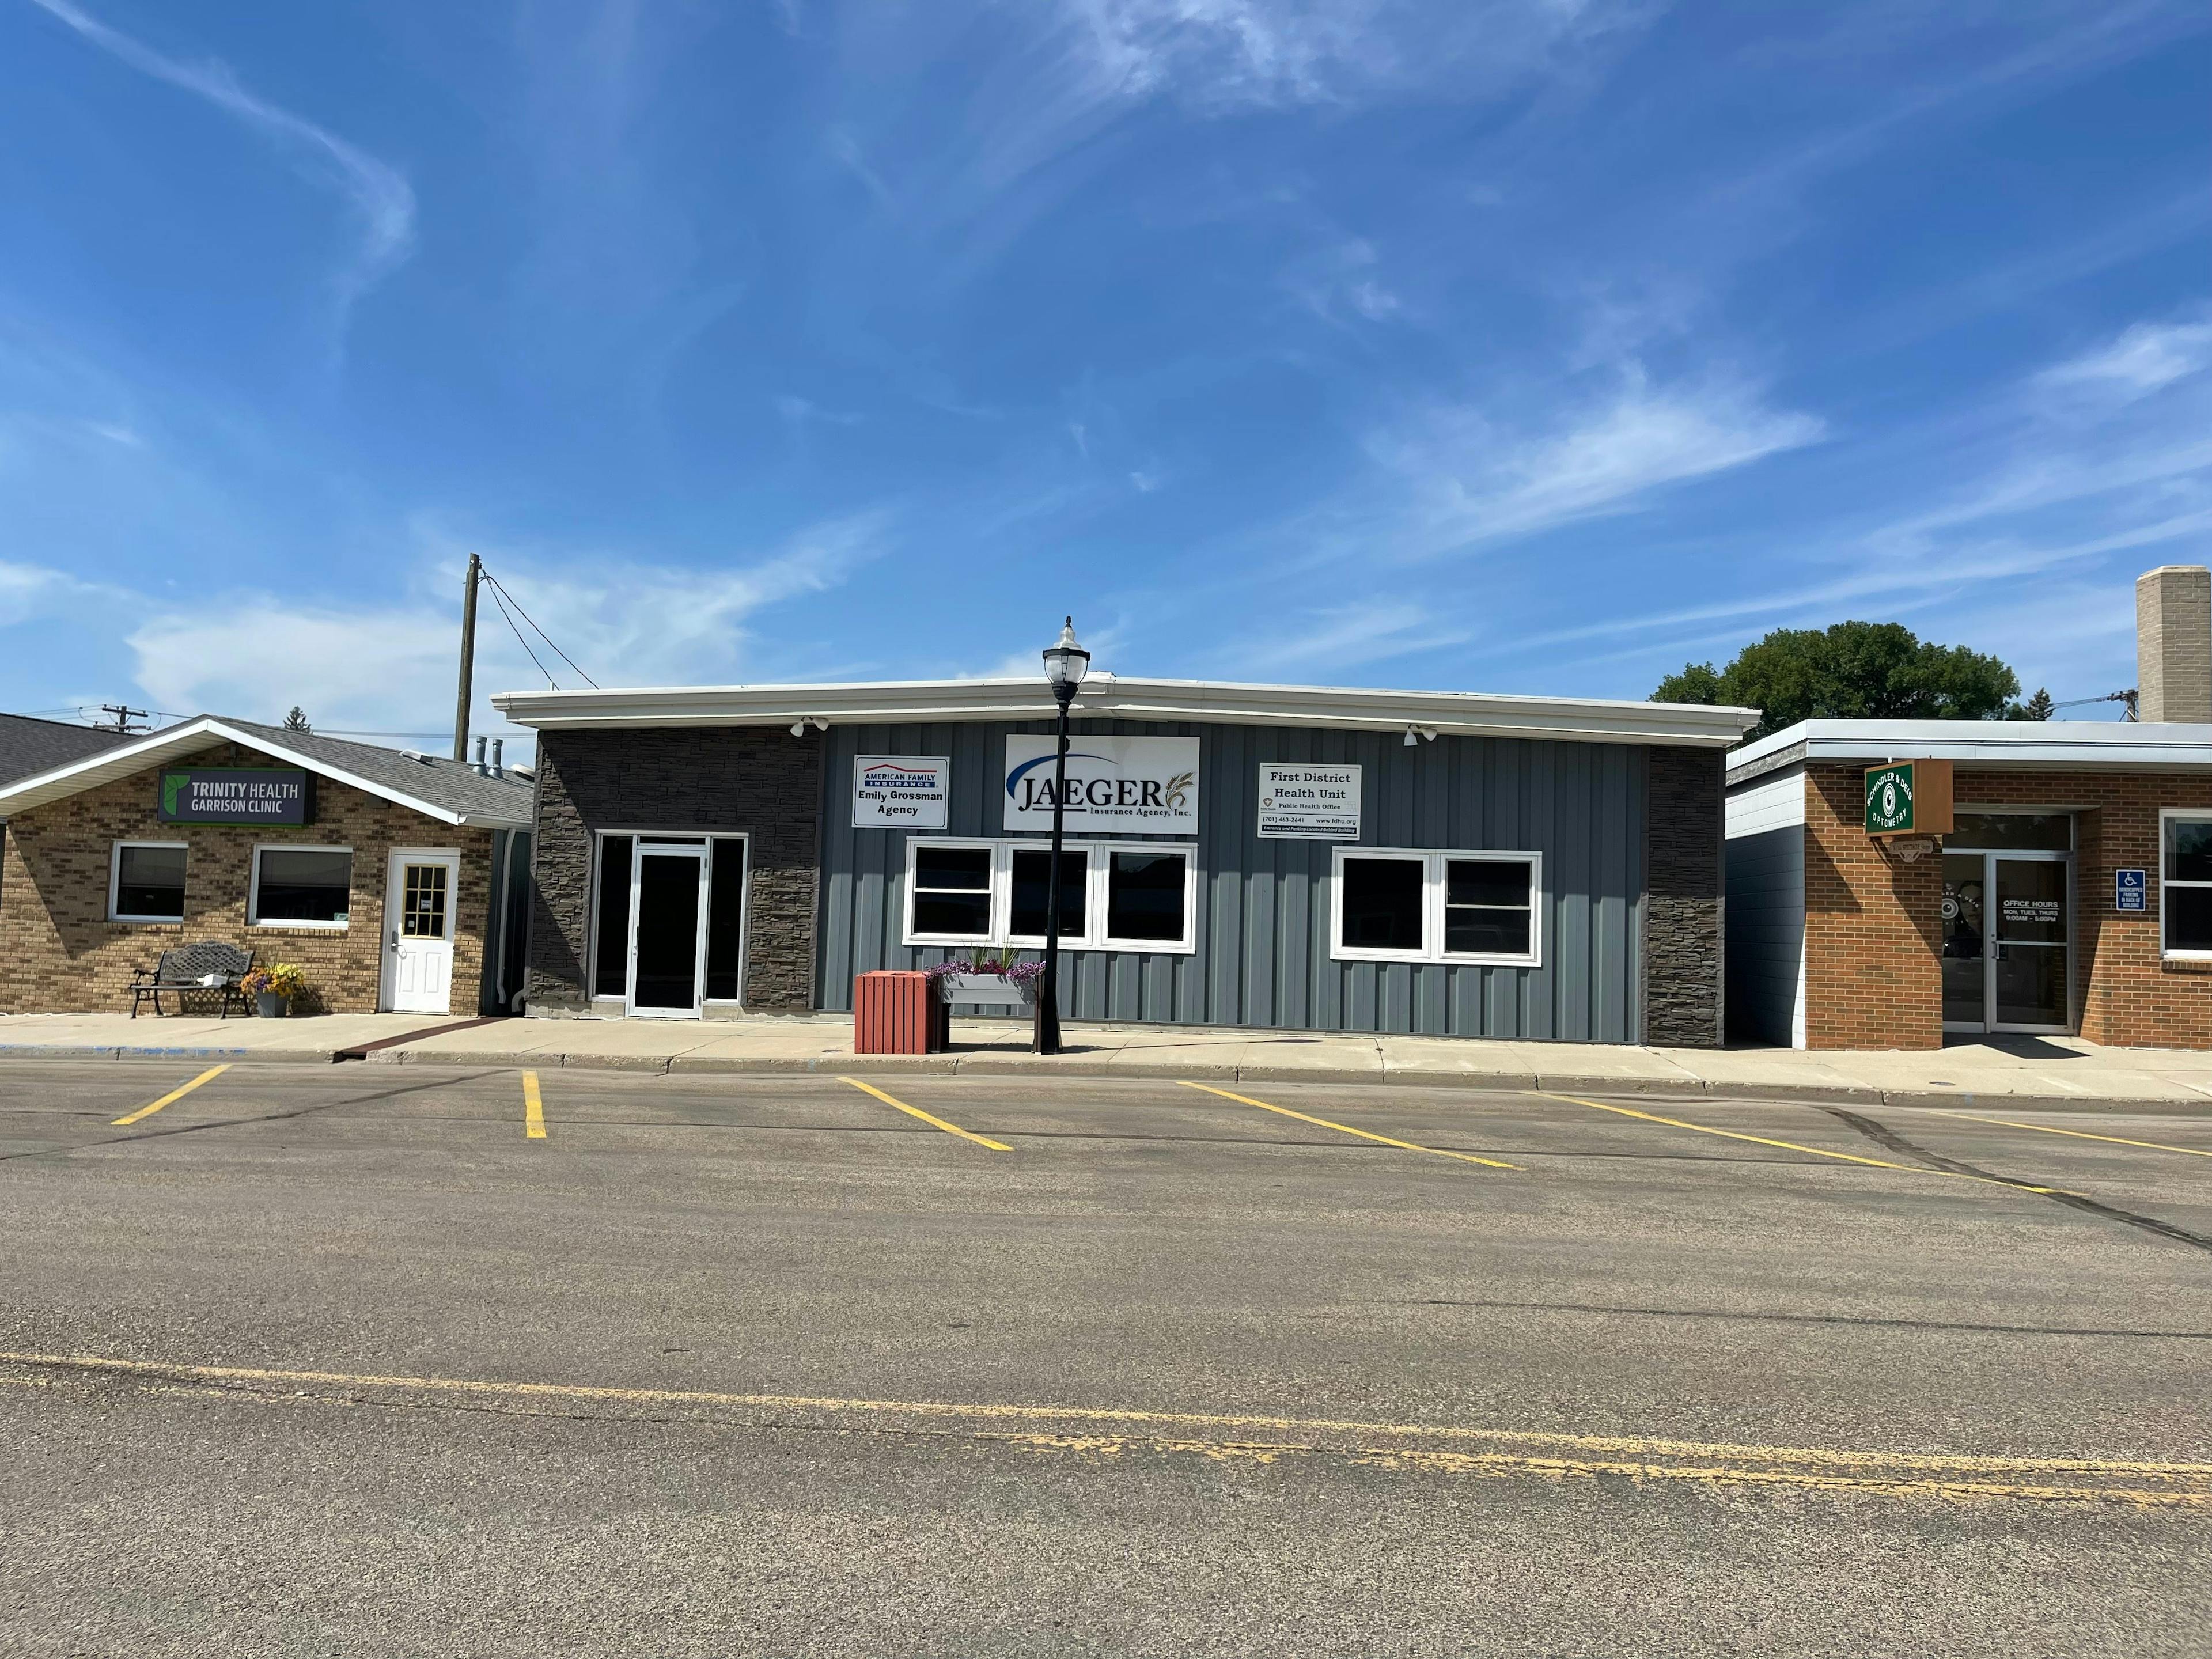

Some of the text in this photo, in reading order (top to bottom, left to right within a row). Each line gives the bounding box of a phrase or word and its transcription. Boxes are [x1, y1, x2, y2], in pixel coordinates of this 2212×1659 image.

[1271, 772, 1351, 782] First District
[192, 782, 298, 798] TRINITY HEALTH
[1018, 778, 1164, 812] JAEGER
[1274, 788, 1346, 798] Health Unit
[1867, 772, 1912, 806] SCHINDLER & DEIS
[858, 790, 942, 803] Emily Grossman
[191, 799, 282, 813] GARRISON CLINIC
[878, 805, 918, 816] Agency
[1090, 807, 1133, 815] Insurance
[1137, 808, 1171, 817] Agency,
[1873, 808, 1906, 828] OPTOMETRY
